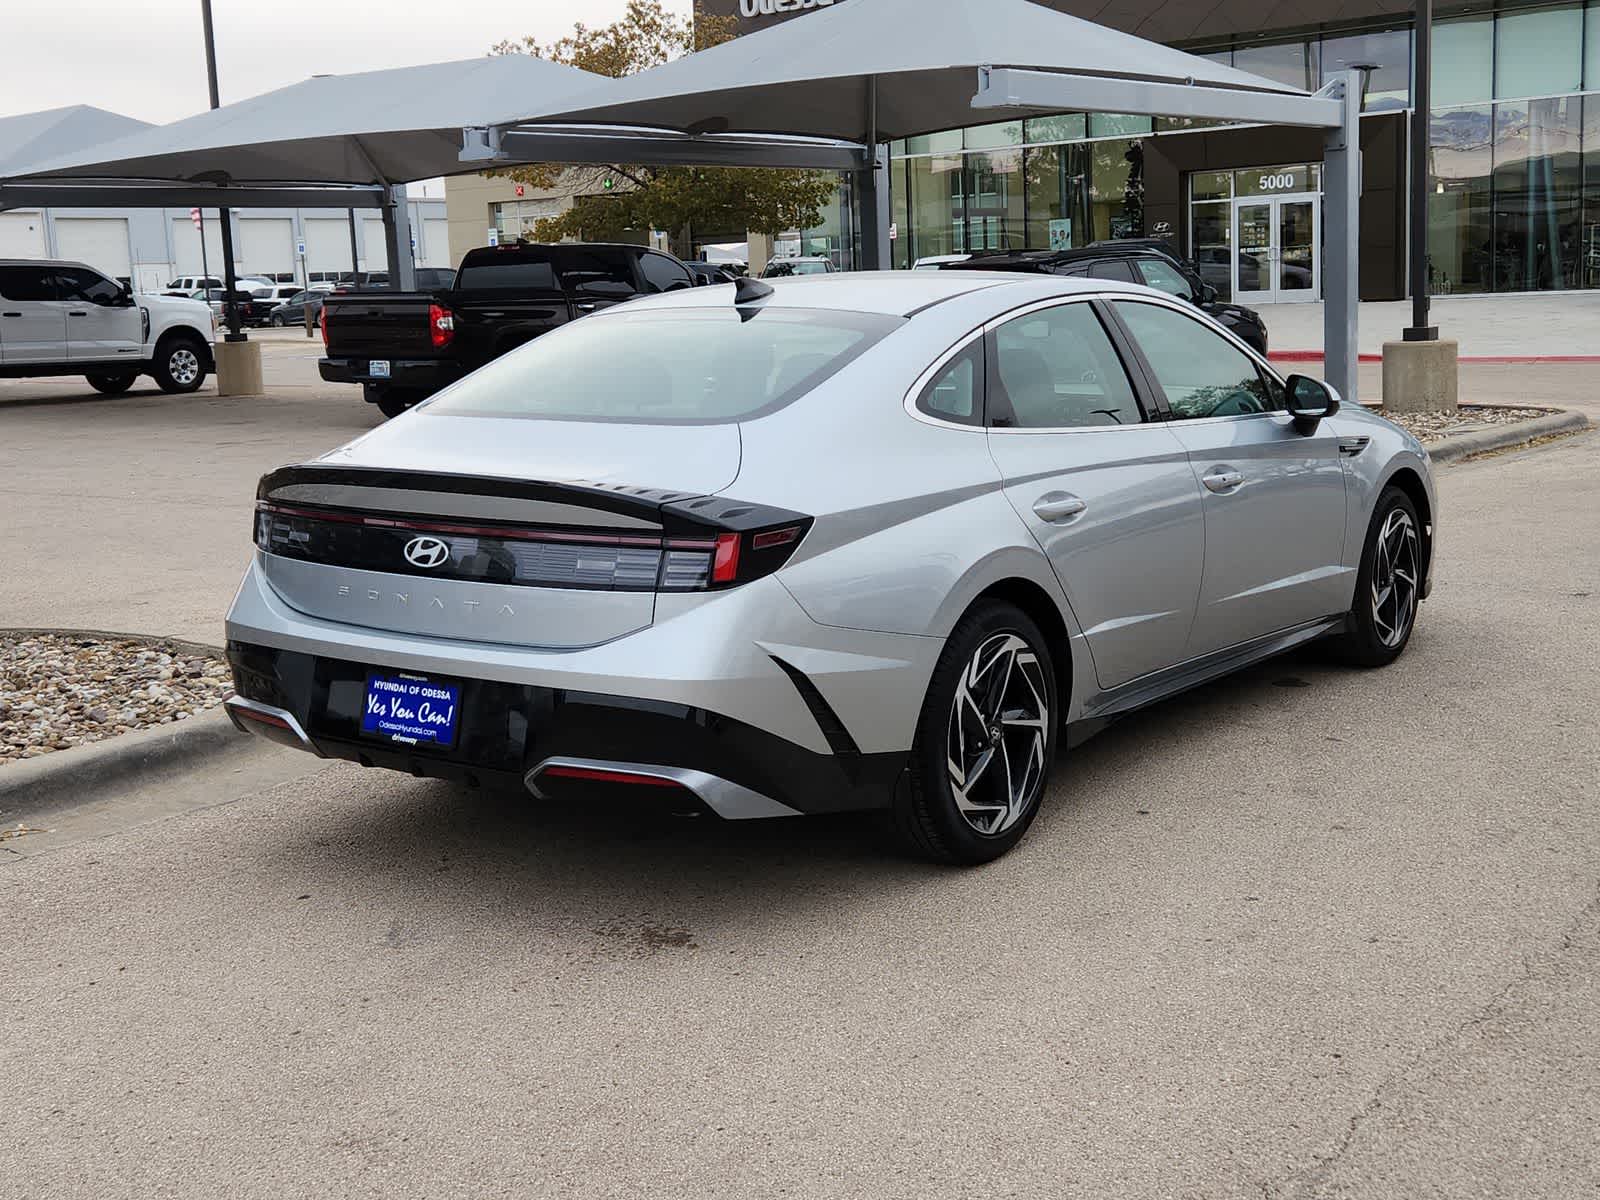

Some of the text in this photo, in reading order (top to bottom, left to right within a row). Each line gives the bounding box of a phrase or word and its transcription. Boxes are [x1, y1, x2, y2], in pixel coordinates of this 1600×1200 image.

[1259, 174, 1294, 190] 5000
[337, 585, 515, 616] SONATA
[374, 680, 451, 700] HYUNDAI OF ODESSA
[367, 693, 454, 727] Yes You Can!
[379, 720, 437, 737] OdessaHyundai.com
